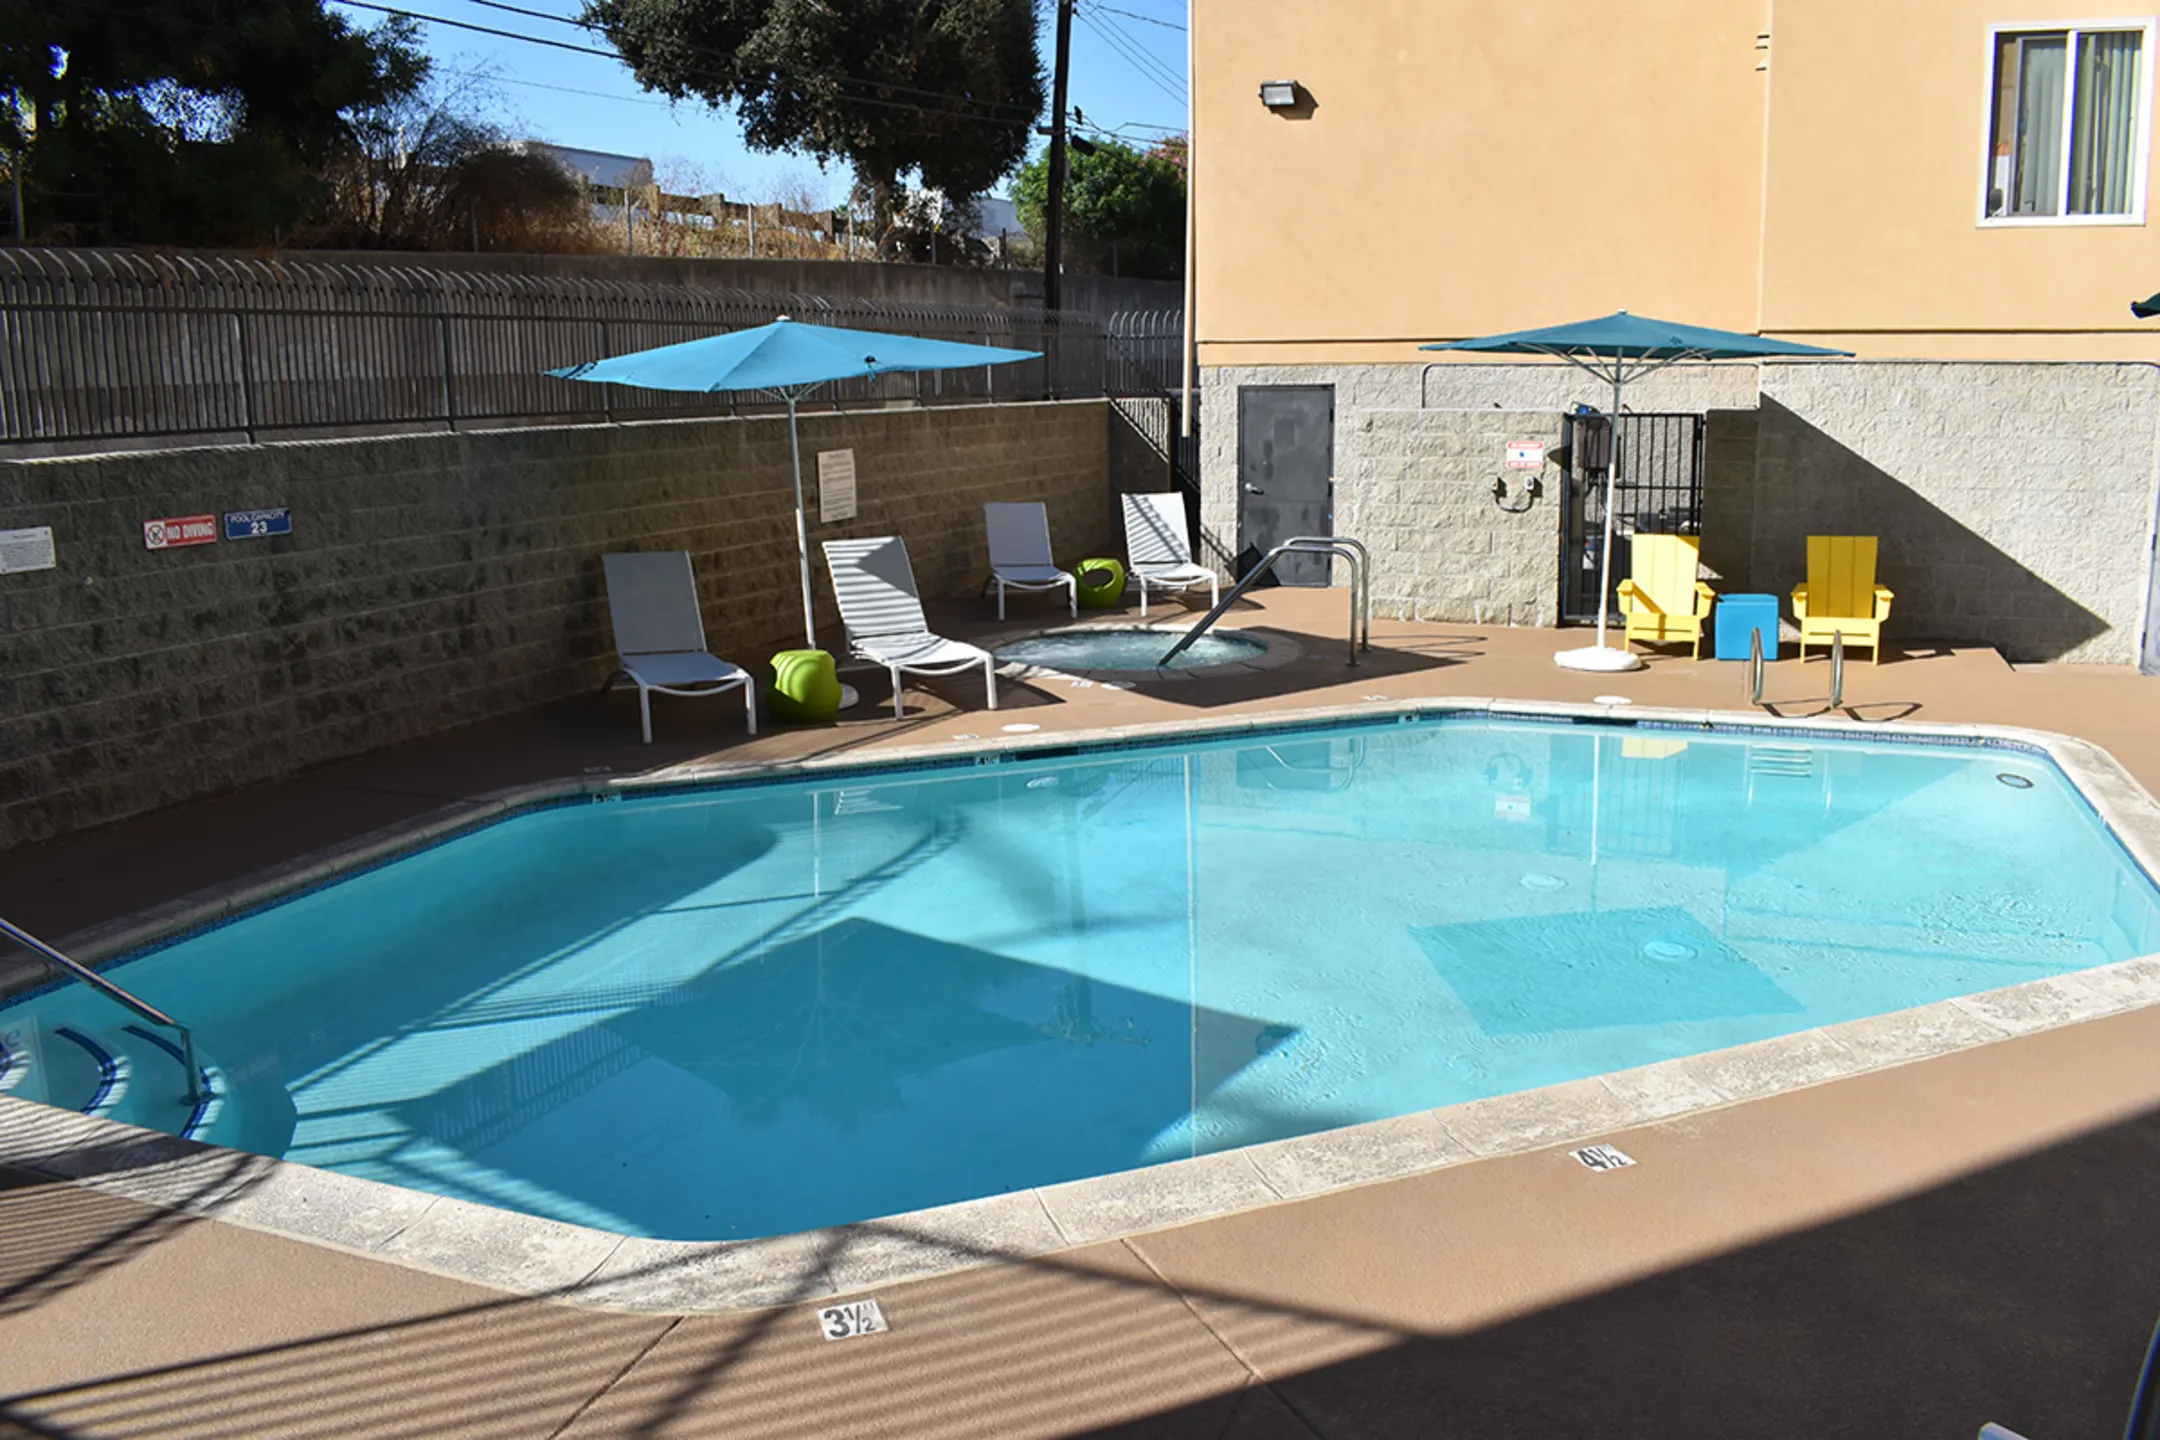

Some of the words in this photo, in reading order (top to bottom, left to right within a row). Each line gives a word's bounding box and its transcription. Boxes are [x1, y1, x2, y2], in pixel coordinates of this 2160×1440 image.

[166, 525, 181, 540] NO
[182, 522, 213, 539] DIVING
[251, 520, 267, 535] 23
